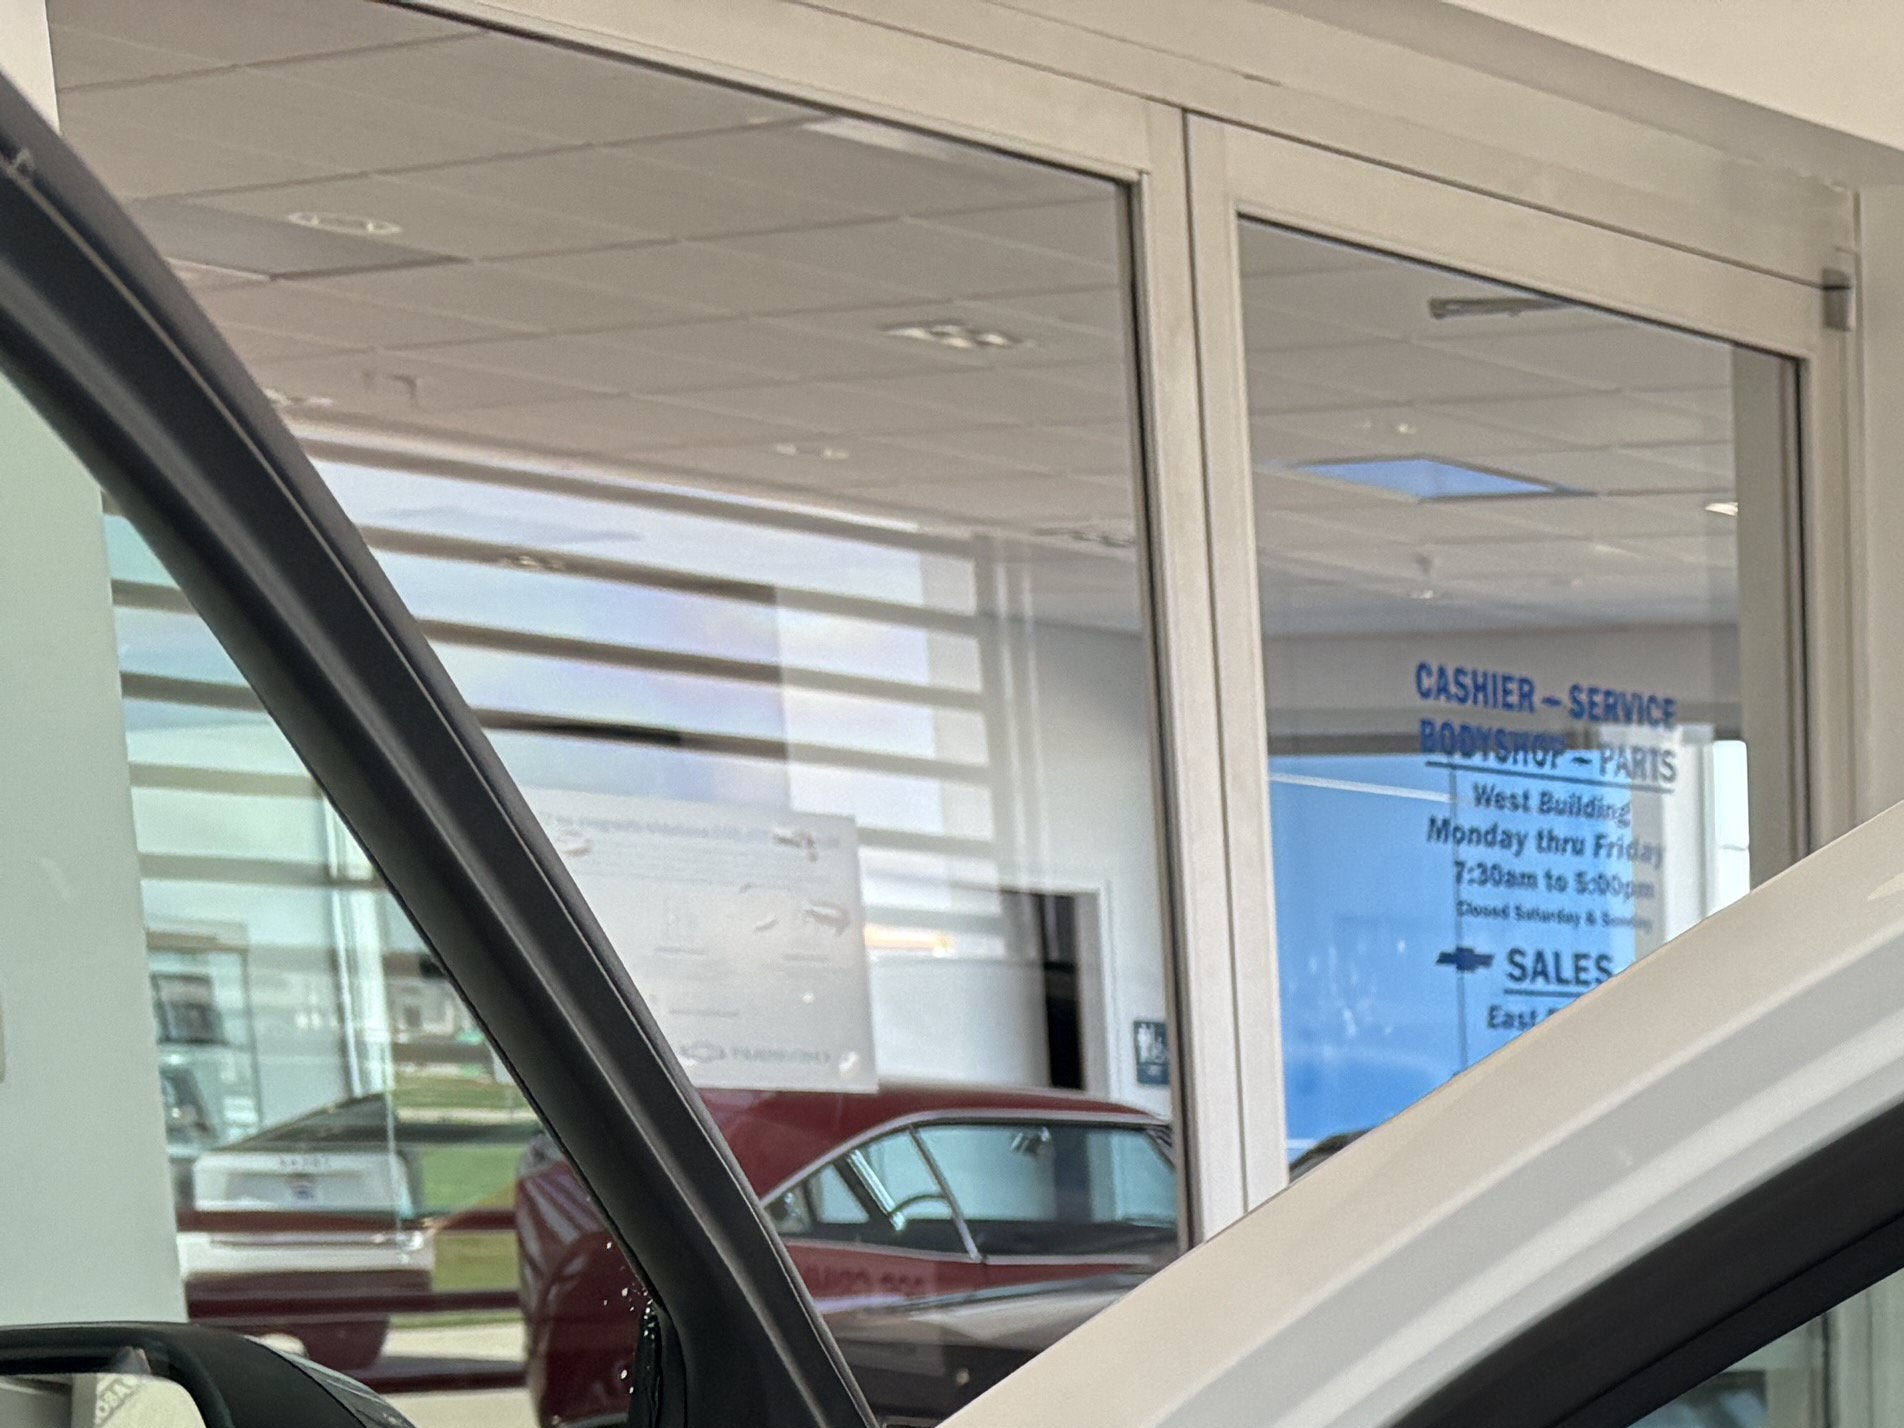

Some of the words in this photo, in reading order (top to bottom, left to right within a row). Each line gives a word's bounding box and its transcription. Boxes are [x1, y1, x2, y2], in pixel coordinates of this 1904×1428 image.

[1415, 660, 1536, 713] CASHIER
[1567, 683, 1677, 728] SERVICE
[1418, 717, 1567, 770] BODYSHOP
[1599, 742, 1678, 783] PARTS
[1473, 782, 1532, 813] West
[1537, 789, 1631, 828] Building
[1427, 814, 1529, 858] Monday
[1535, 827, 1586, 857] thru
[1593, 831, 1665, 869] Friday
[1453, 858, 1539, 890] 7:30am
[1544, 868, 1569, 893] to
[1574, 870, 1656, 903] 5:00pm
[1454, 899, 1511, 920] Closed
[1512, 902, 1581, 929] Saturday
[1505, 947, 1613, 986] SALES
[1486, 1003, 1540, 1031] East
